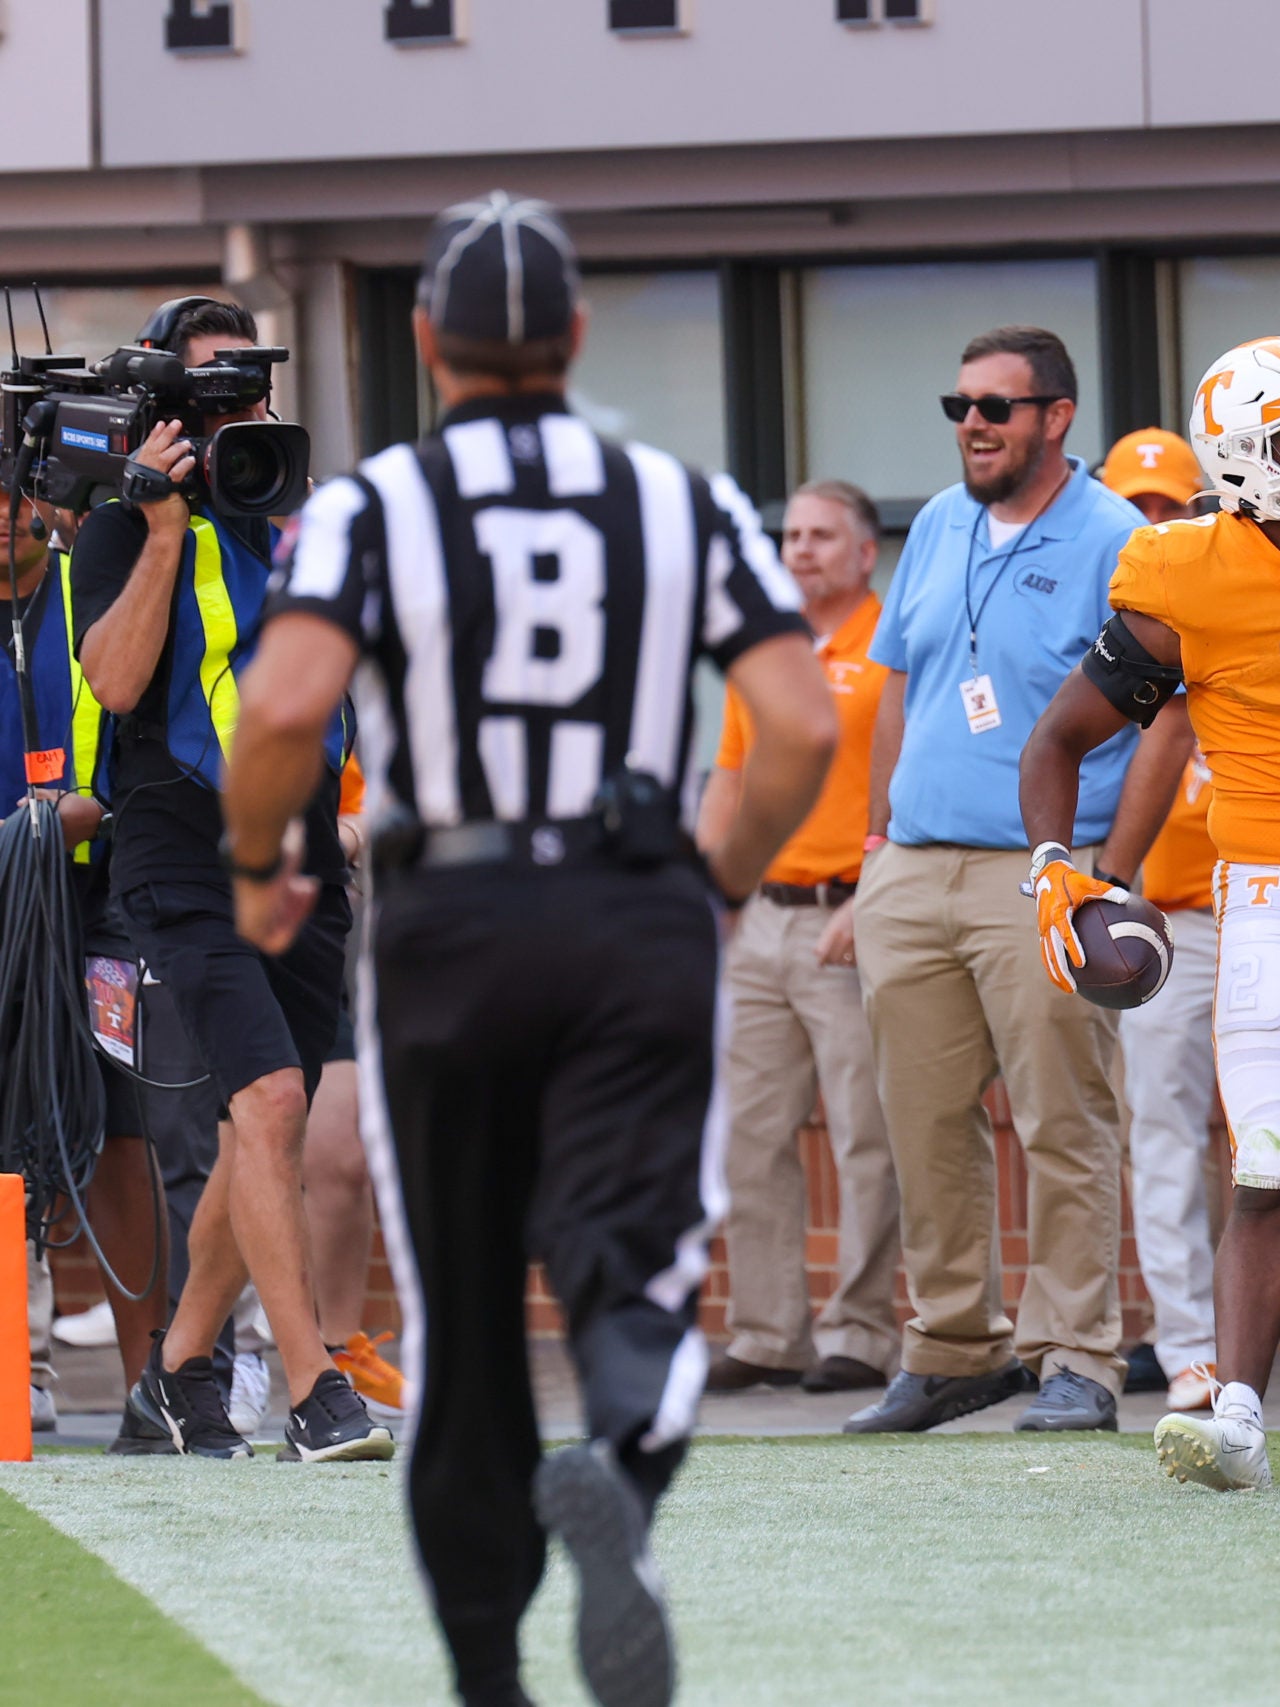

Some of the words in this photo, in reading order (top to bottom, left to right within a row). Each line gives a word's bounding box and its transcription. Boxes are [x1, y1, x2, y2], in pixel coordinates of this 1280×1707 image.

[1135, 443, 1165, 468] T
[473, 505, 606, 706] B
[1228, 953, 1260, 1012] 2
